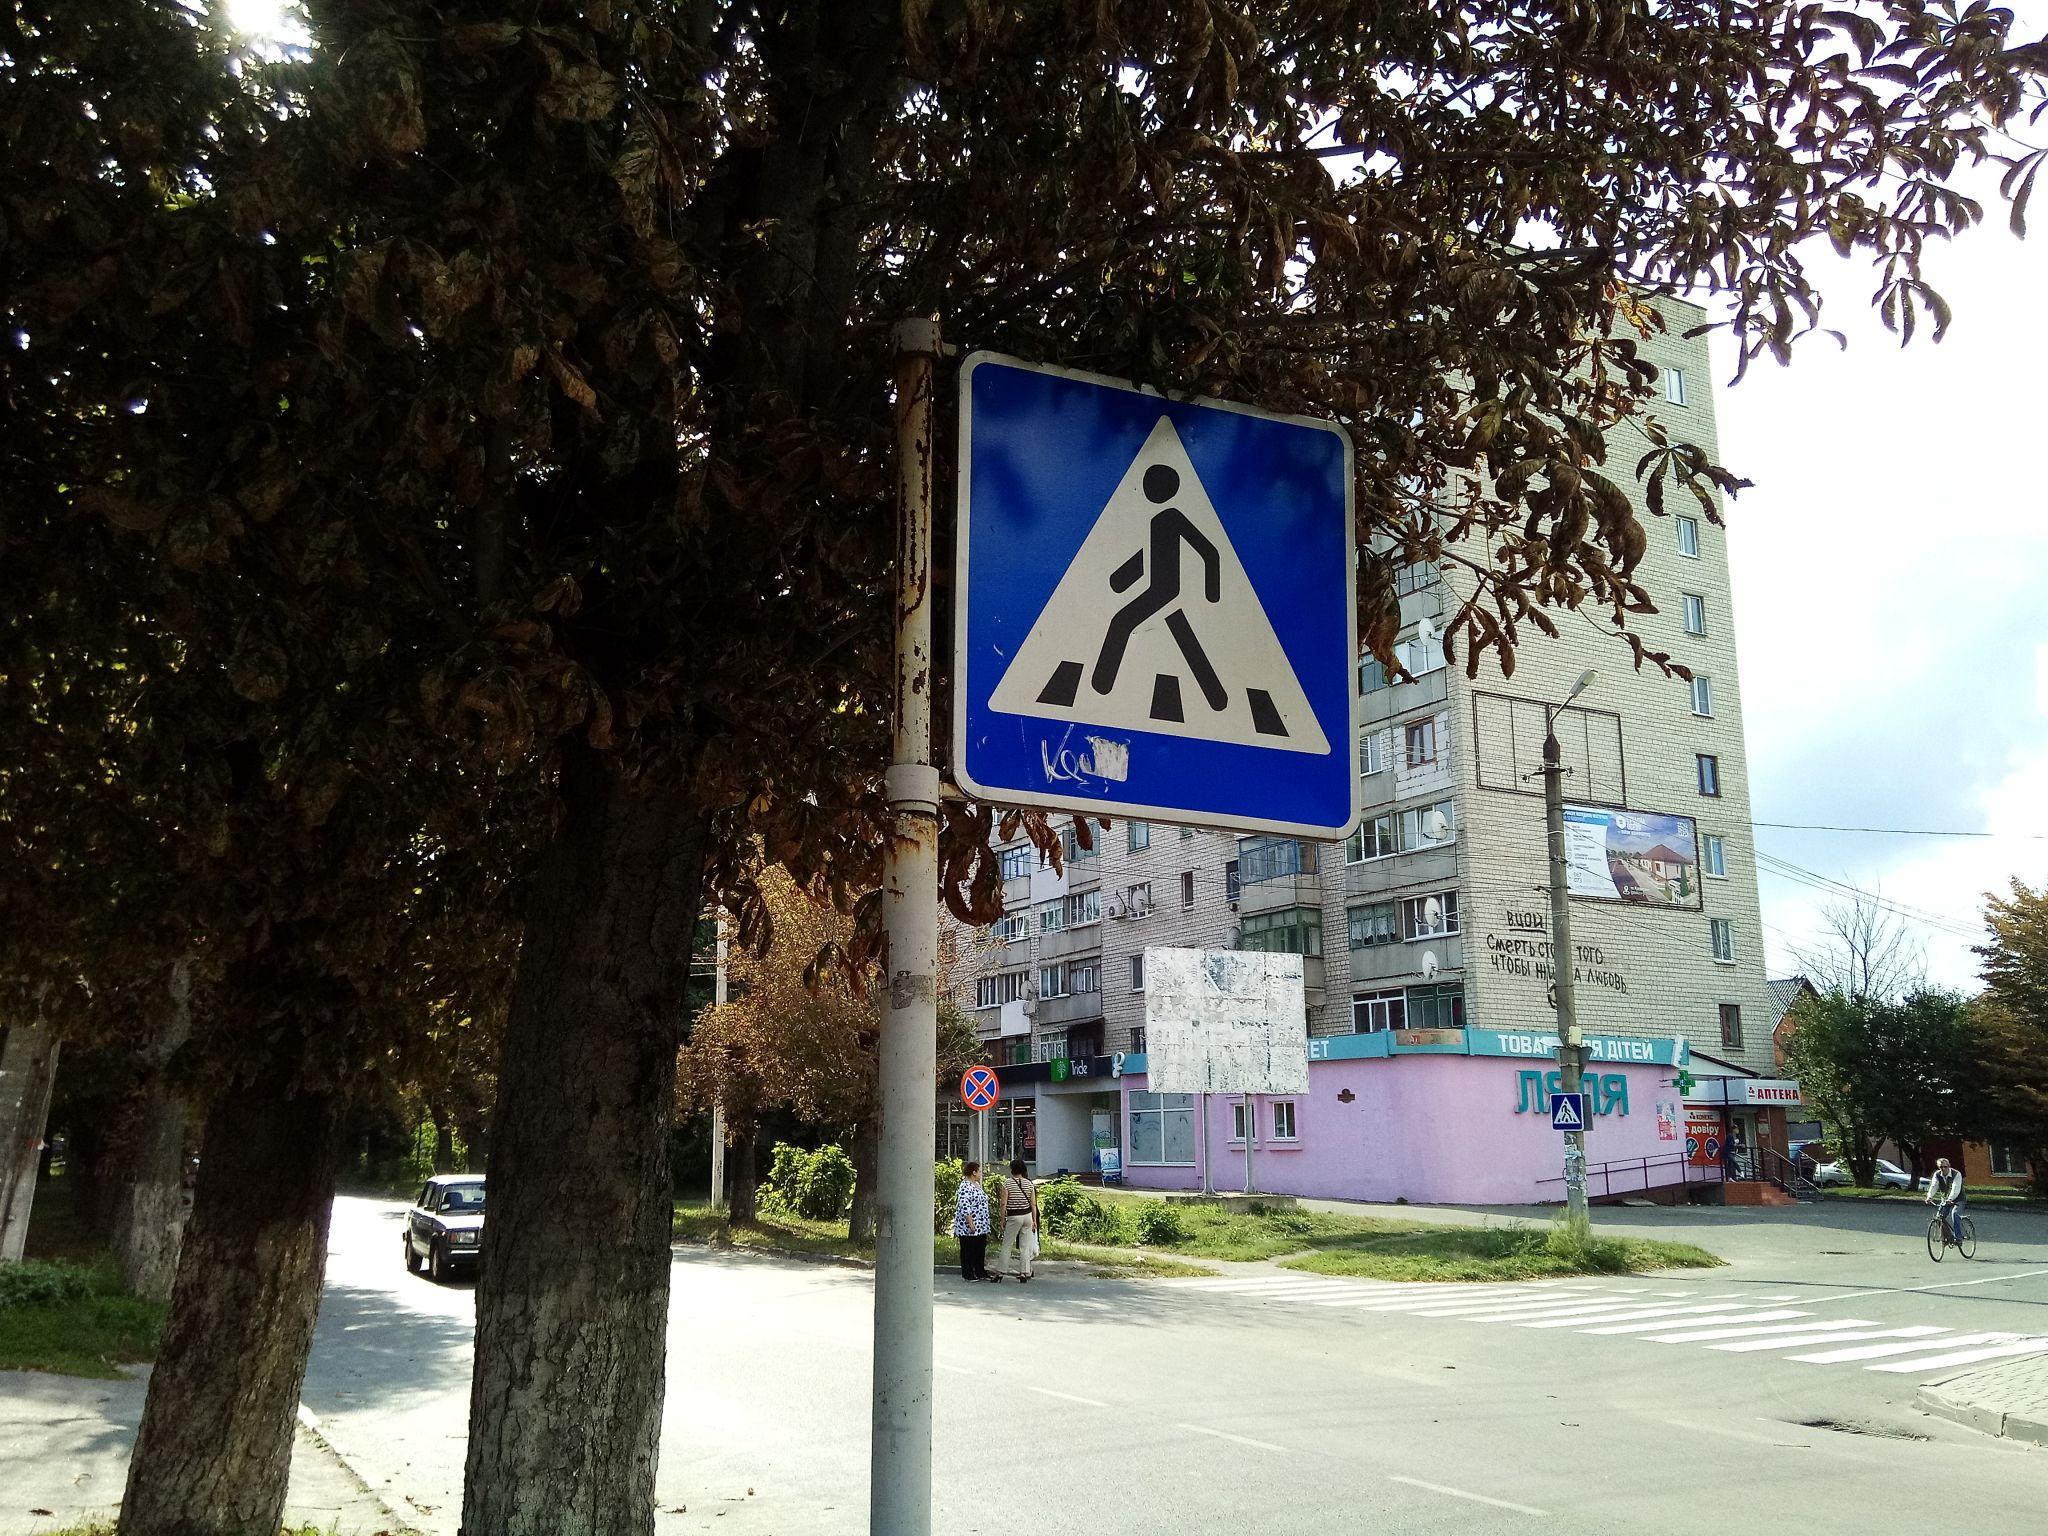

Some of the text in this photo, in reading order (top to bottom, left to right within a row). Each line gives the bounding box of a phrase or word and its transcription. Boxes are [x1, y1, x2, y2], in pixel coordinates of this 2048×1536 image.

[1498, 1034, 1549, 1055] ТОВА
[1607, 1038, 1654, 1061] ДІТЕЙ
[1757, 1088, 1799, 1100] АПТЕКА
[1691, 1123, 1720, 1136] довіру
